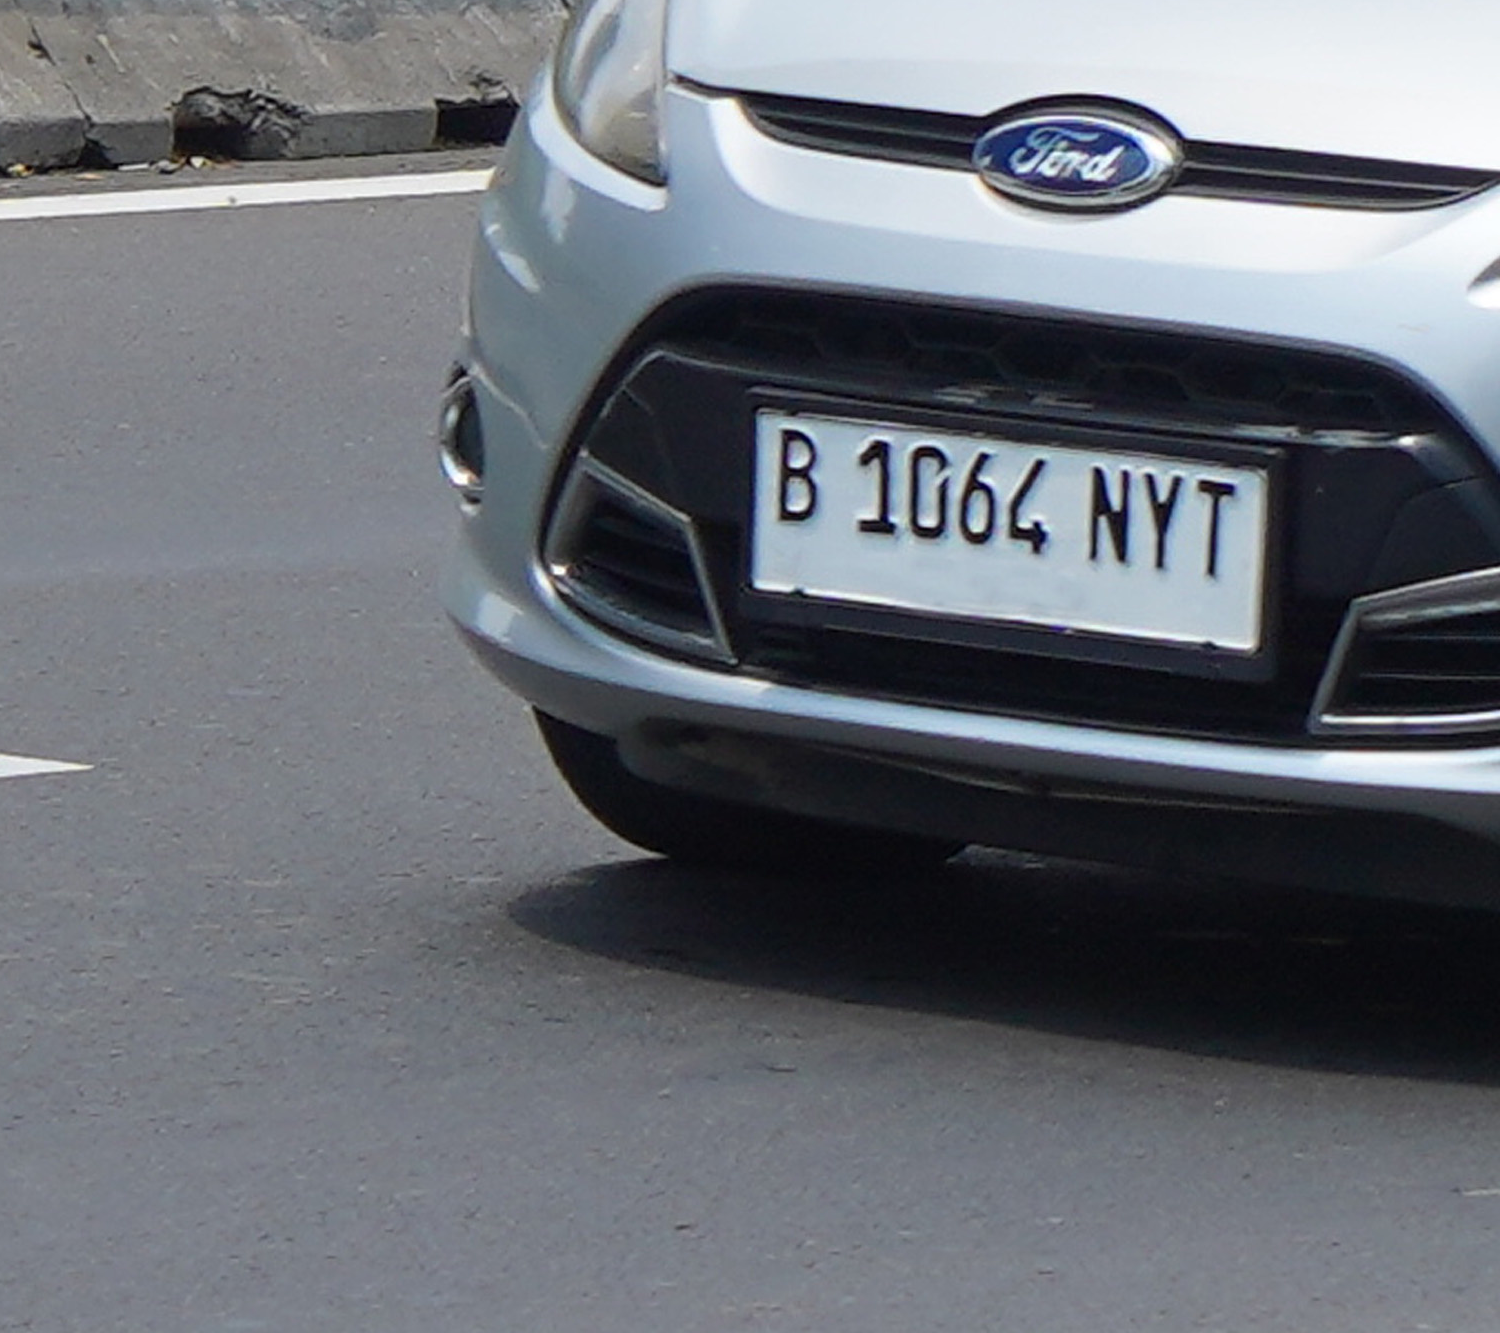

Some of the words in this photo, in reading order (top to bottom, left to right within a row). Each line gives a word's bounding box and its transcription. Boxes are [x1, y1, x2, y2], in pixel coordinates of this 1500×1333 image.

[1009, 126, 1126, 182] Ford
[778, 429, 818, 523] B
[858, 440, 1048, 555] 1064
[1090, 465, 1237, 578] NYT
